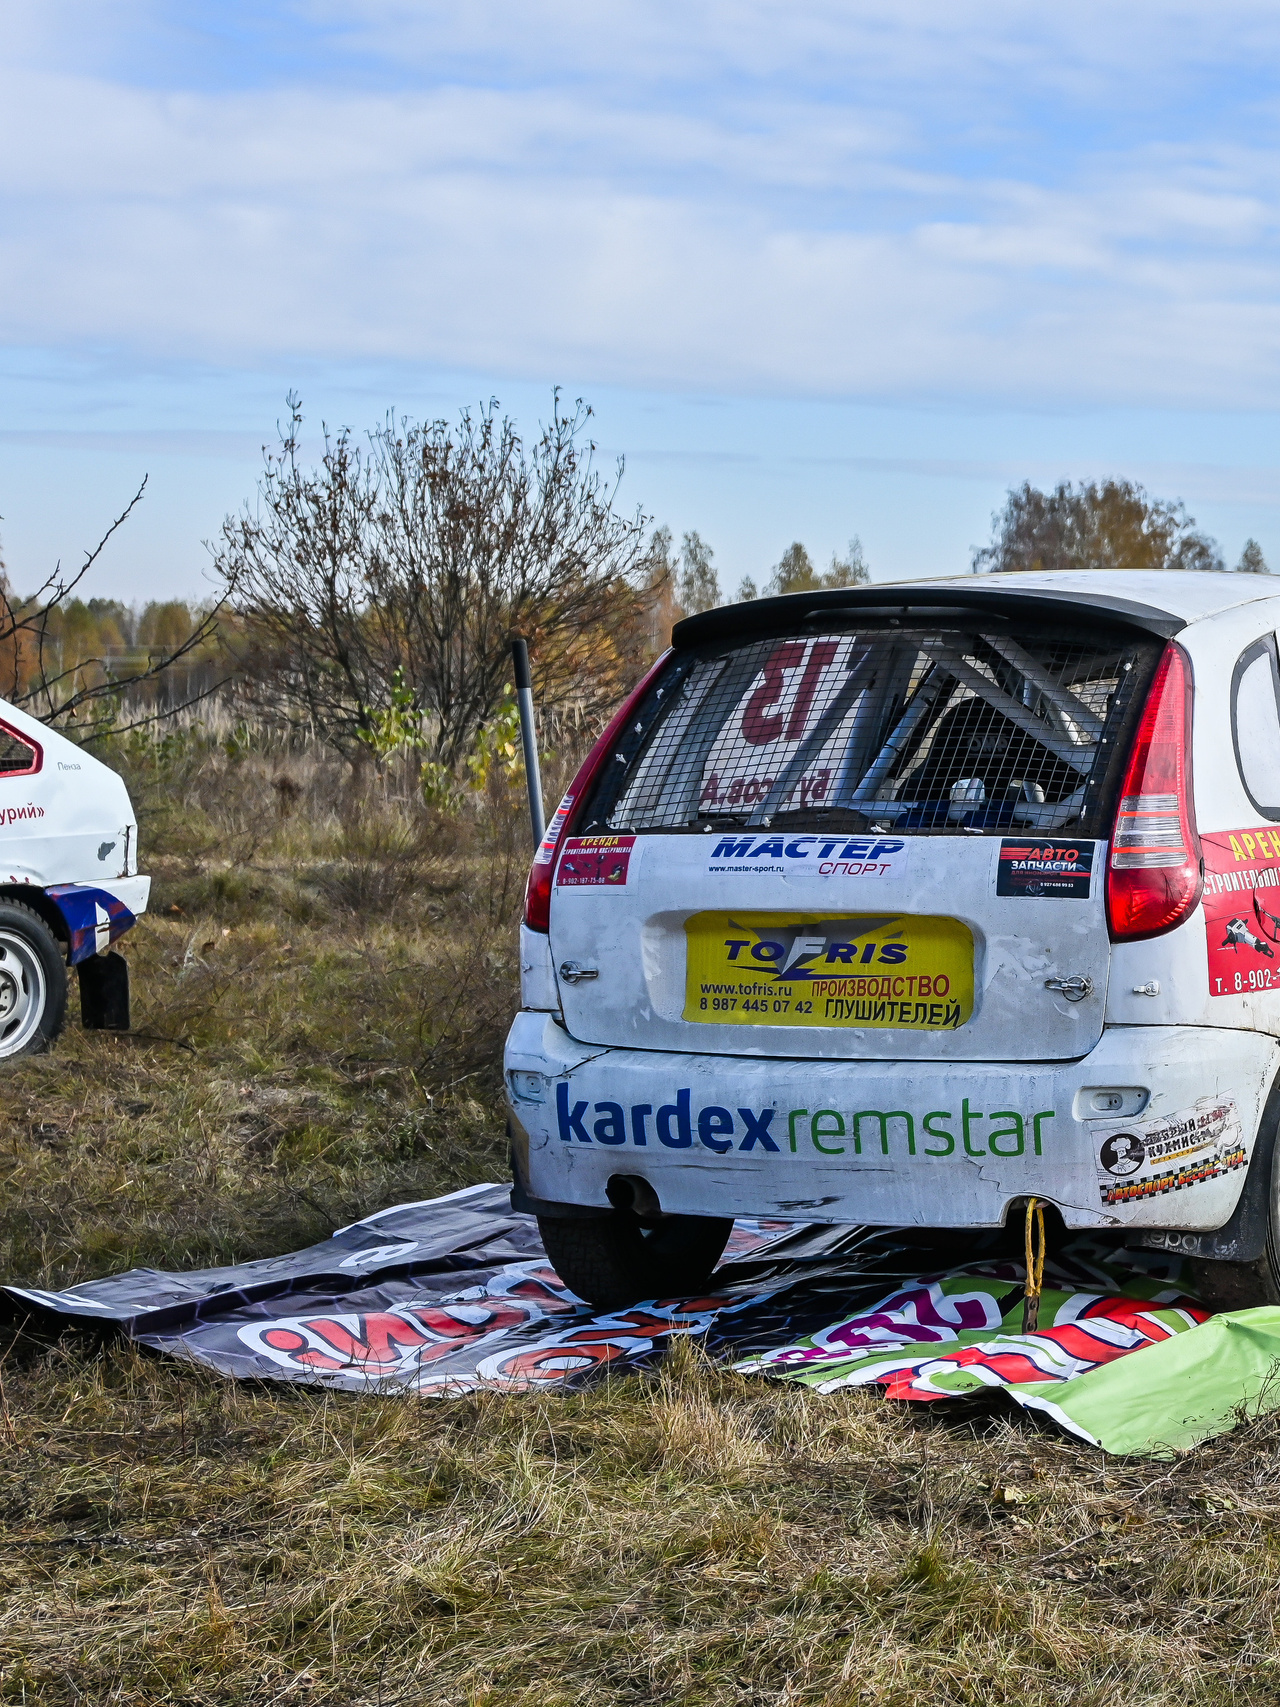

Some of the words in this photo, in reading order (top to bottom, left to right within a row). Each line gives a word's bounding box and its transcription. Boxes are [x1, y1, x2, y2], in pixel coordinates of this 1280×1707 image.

[57, 761, 82, 771] Пенза
[580, 837, 619, 847] АРЕНДА
[710, 836, 905, 860] МАСТЕР
[1027, 848, 1079, 862] АВТО
[708, 865, 785, 874] www.master-sport.ru
[818, 862, 891, 876] СПОРТ
[1011, 860, 1077, 871] ЗАПЧАСТИ
[724, 936, 909, 975] TOFRIS
[700, 982, 792, 997] www.tofris.ru
[811, 974, 950, 1001] ПРОИЗВОДСТВО
[699, 997, 708, 1010] 8
[712, 997, 737, 1011] 987
[742, 999, 768, 1013] 445
[773, 1000, 790, 1013] 07
[795, 1001, 813, 1014] 42
[825, 999, 961, 1027] ГЛУШИТЕЛЕЙ
[556, 1080, 780, 1153] kardex
[786, 1096, 1056, 1157] remstar
[1107, 1174, 1175, 1201] АВТОСПОРТ
